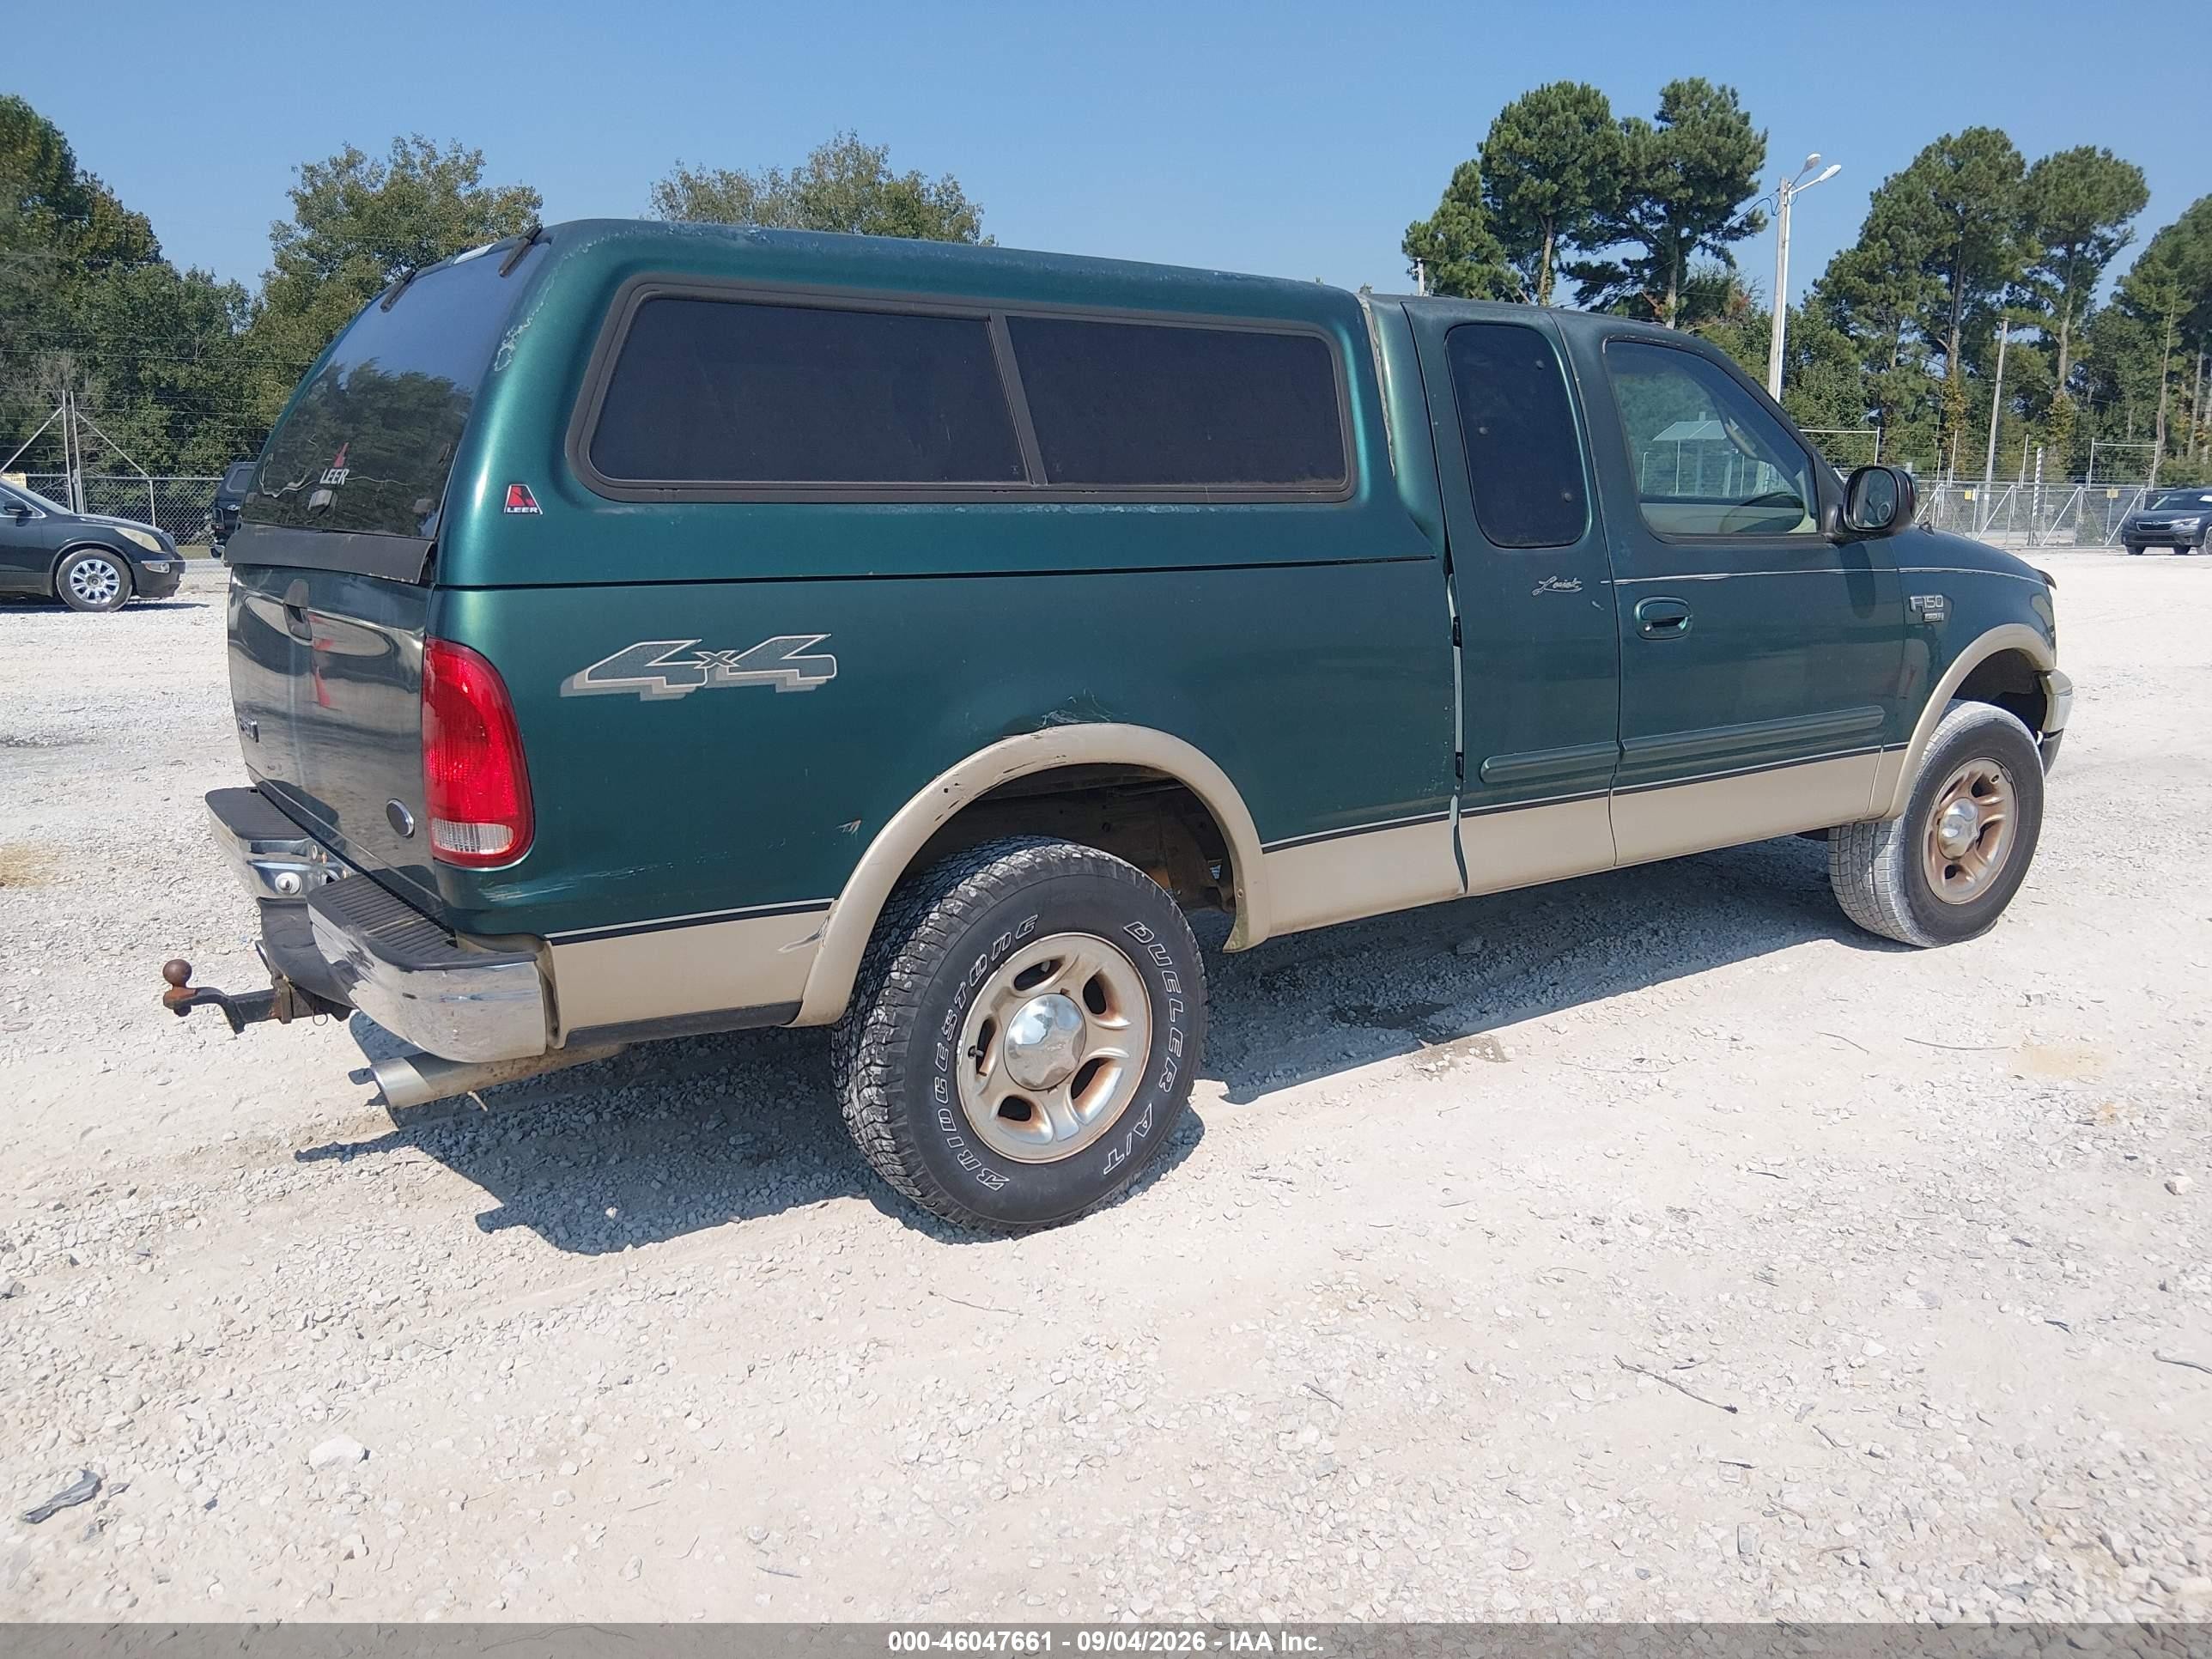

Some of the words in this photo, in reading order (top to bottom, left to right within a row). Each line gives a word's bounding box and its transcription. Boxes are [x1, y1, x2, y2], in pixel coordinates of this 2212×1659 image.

[319, 468, 350, 485] LEER
[933, 914, 1039, 1192] BRIDGESTONE
[1123, 921, 1185, 1094] DUELER
[1103, 1103, 1152, 1176] A/T
